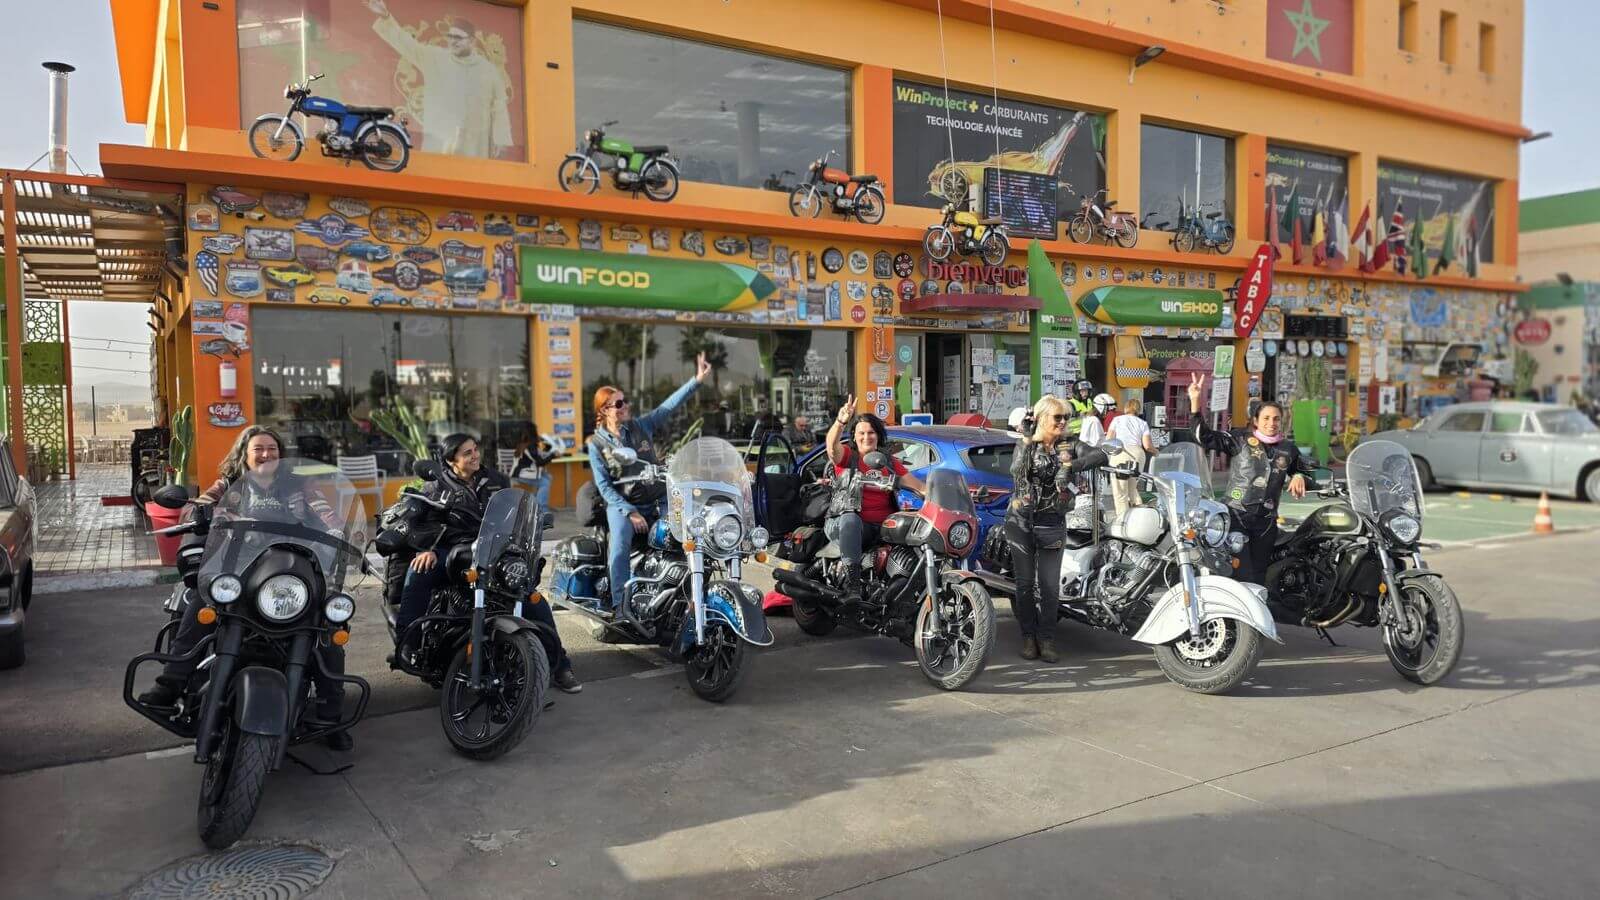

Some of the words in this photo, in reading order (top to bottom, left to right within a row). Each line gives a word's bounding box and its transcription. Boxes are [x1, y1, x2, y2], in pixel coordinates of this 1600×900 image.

[983, 104, 1049, 124] CARBURANTS
[926, 115, 984, 133] TECHNOLOGIE
[984, 126, 1023, 138] AVANCÉE
[537, 264, 650, 289] WINFOOD
[1240, 254, 1267, 328] TABAC
[851, 310, 865, 318] STOP
